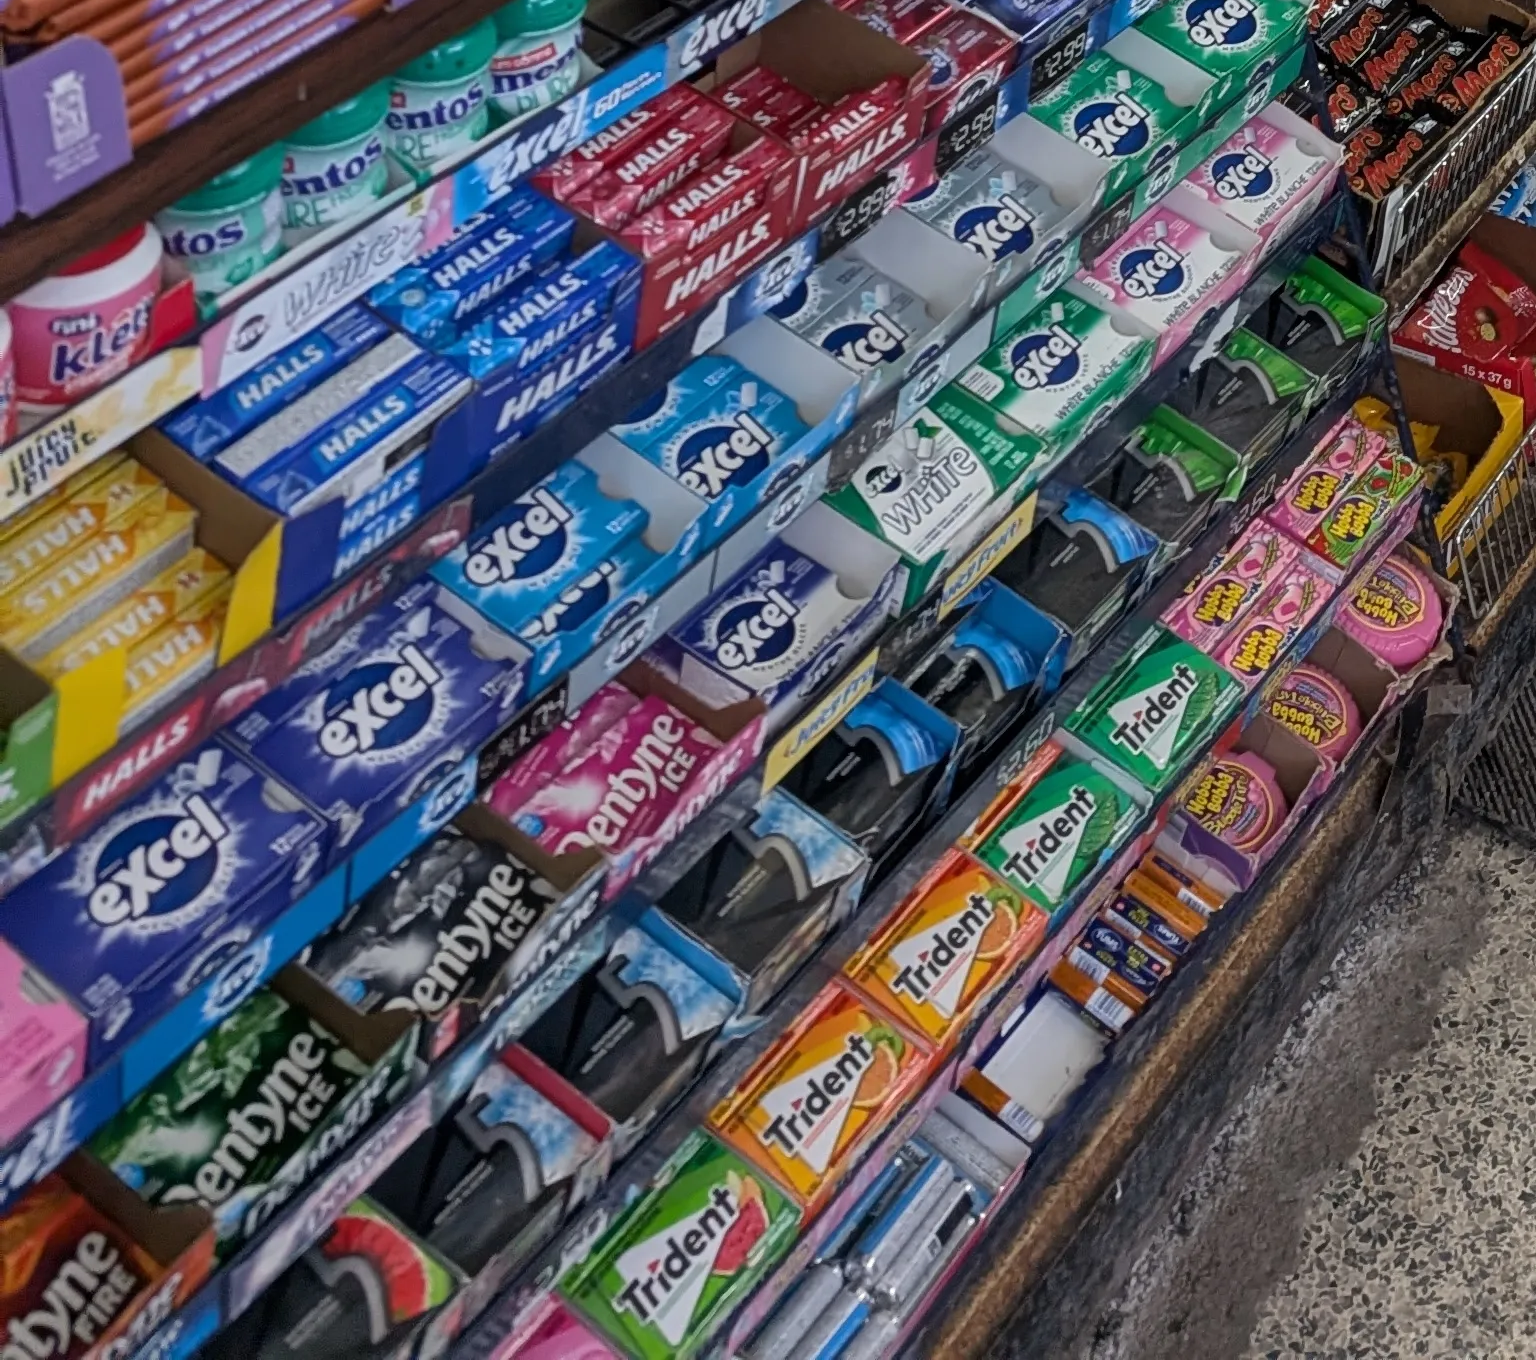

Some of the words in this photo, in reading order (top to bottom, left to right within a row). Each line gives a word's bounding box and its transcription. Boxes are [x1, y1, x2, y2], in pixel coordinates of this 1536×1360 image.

[1329, 7, 1384, 64] Mars
[1363, 31, 1418, 91] Mars
[1453, 35, 1520, 107] Mars
[1213, 146, 1273, 200] excel
[667, 213, 770, 310] HALLS
[1123, 240, 1184, 298] excel
[236, 339, 325, 411] HALLS
[498, 324, 618, 433] HALLS
[318, 391, 406, 464] HALLS
[884, 444, 978, 535] WHITE
[466, 488, 572, 588] excel
[716, 588, 801, 667] excel
[320, 644, 442, 760] excel
[1114, 663, 1196, 753] Trident
[659, 748, 697, 796] ICE
[88, 794, 228, 929] excel
[491, 899, 538, 954] ICE
[894, 891, 994, 1003] Trident
[289, 1074, 338, 1133] ICE
[764, 1031, 873, 1159] Trident
